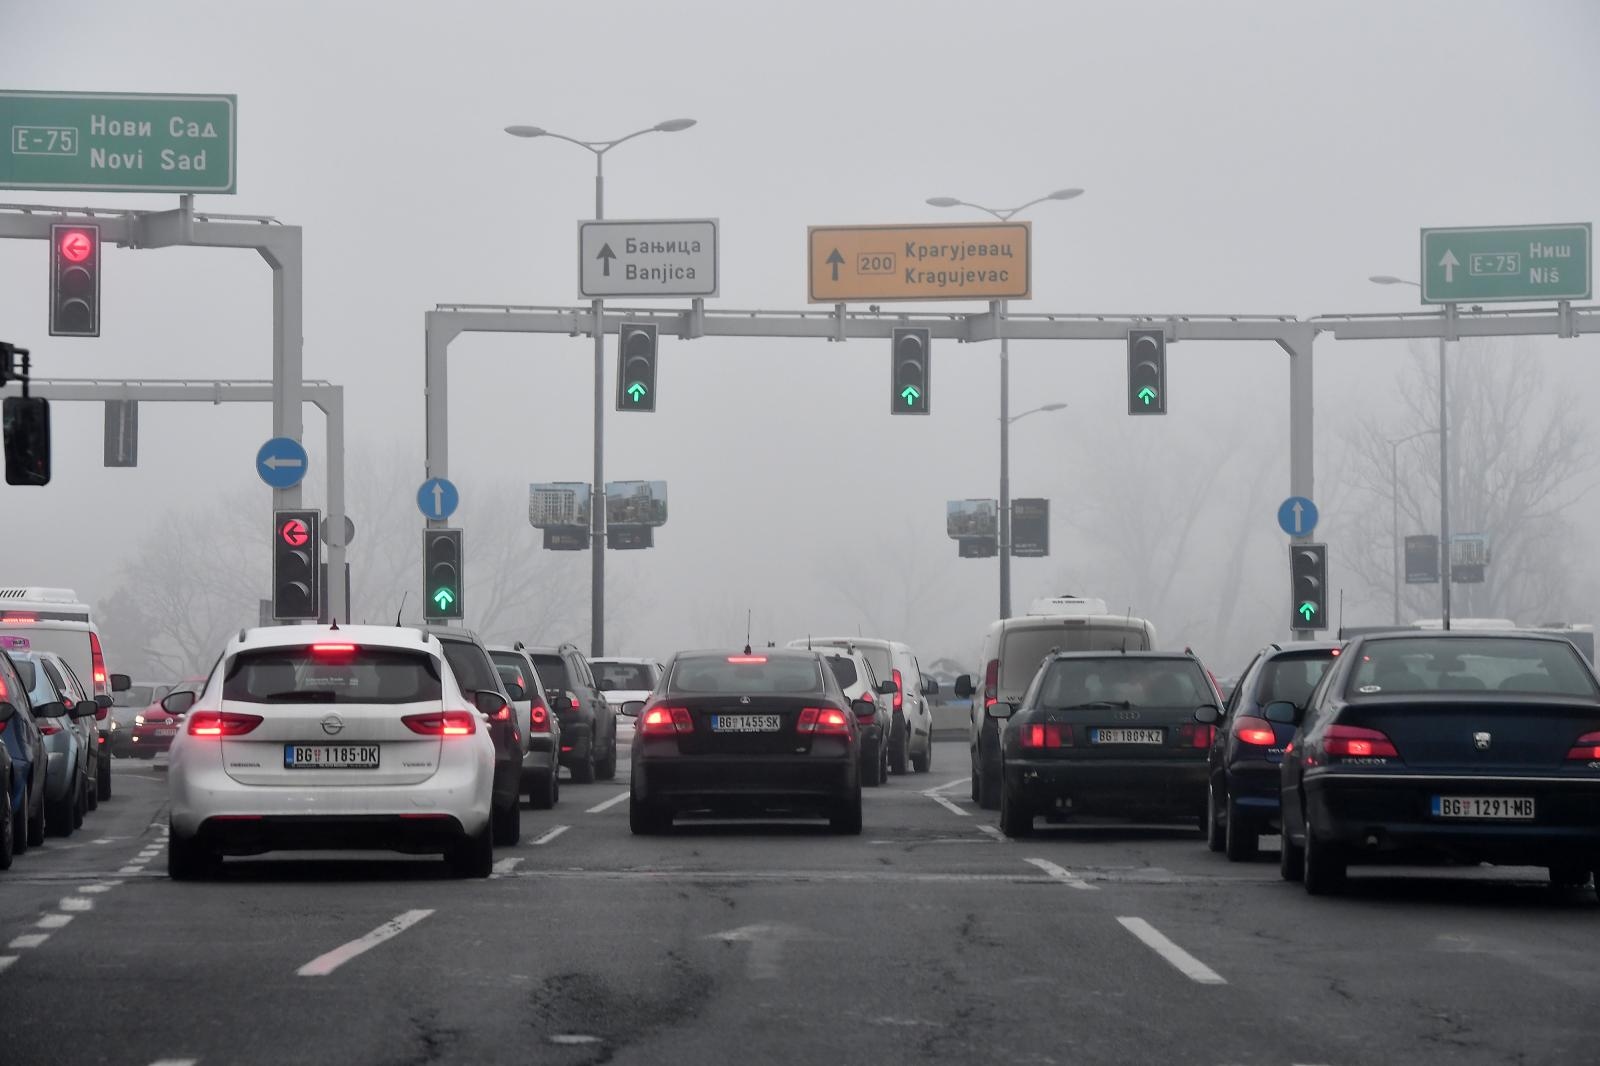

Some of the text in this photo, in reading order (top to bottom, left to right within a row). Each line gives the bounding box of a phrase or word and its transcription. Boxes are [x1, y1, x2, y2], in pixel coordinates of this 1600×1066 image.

[90, 114, 218, 138] Нови Сад
[18, 130, 72, 151] E-75
[90, 148, 206, 171] Novi Sad
[625, 237, 701, 255] Бањица
[905, 241, 1014, 261] Крагујевац
[1529, 242, 1571, 259] Ниш
[860, 257, 893, 271] 200
[1473, 255, 1516, 273] E-75
[625, 264, 696, 284] Banjica
[905, 267, 1009, 287] Kragujevac
[1529, 267, 1560, 284] Niš
[719, 716, 732, 728] BG
[1099, 730, 1112, 742] BG
[296, 747, 313, 763] BG
[1443, 799, 1461, 815] BG
